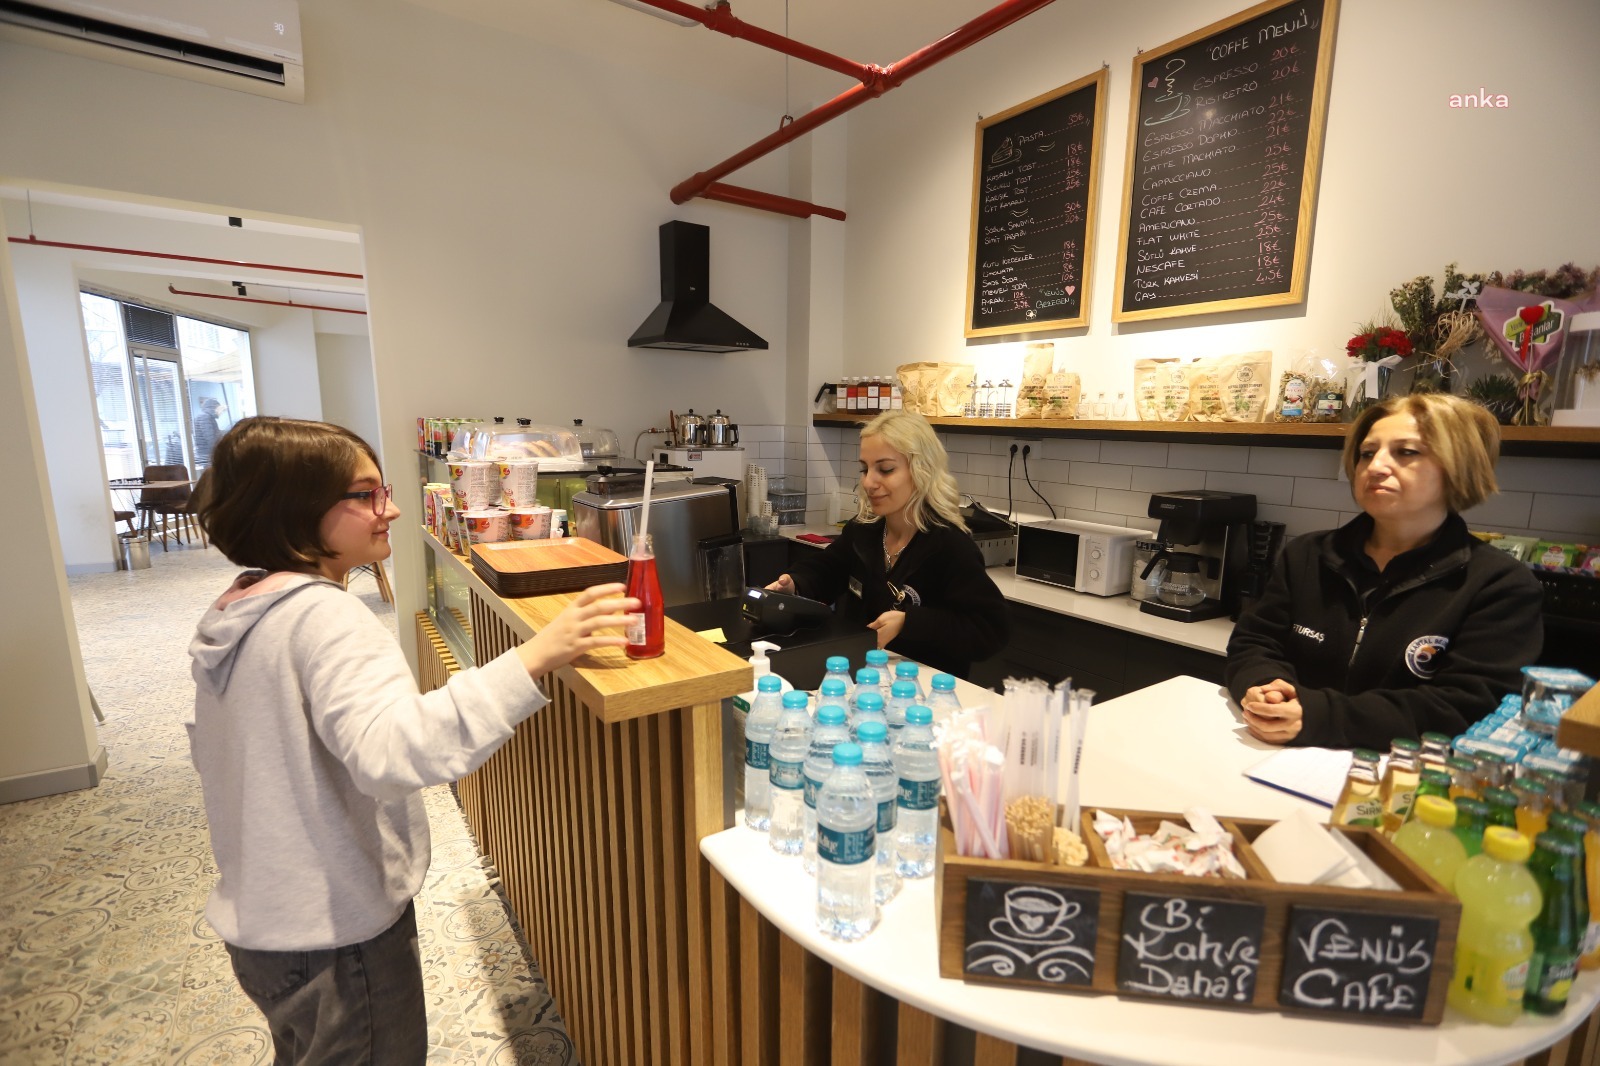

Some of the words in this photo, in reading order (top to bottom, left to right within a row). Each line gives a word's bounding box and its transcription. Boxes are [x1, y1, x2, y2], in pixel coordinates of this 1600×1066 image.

[1193, 62, 1258, 91] ESPRESSO
[1019, 131, 1044, 146] PASTA
[1144, 127, 1194, 147] ESPRESSO
[1142, 142, 1193, 161] ESPRESSO
[1143, 160, 1175, 174] LATTE
[1142, 192, 1174, 206] COFFE
[1174, 196, 1221, 212] CORTADO
[1138, 218, 1196, 233] AMERICANO
[1136, 235, 1162, 246] FLAT
[1170, 229, 1200, 242] WHITE
[1169, 244, 1197, 255] KAHVE
[1136, 259, 1186, 275] NESCAFE
[981, 307, 993, 315] SU
[1140, 898, 1213, 932] Bi
[1123, 930, 1260, 968] Kahve
[1298, 918, 1431, 974] VENÜS
[1123, 963, 1252, 1000] Daha?
[1293, 967, 1417, 1011] CAFE
